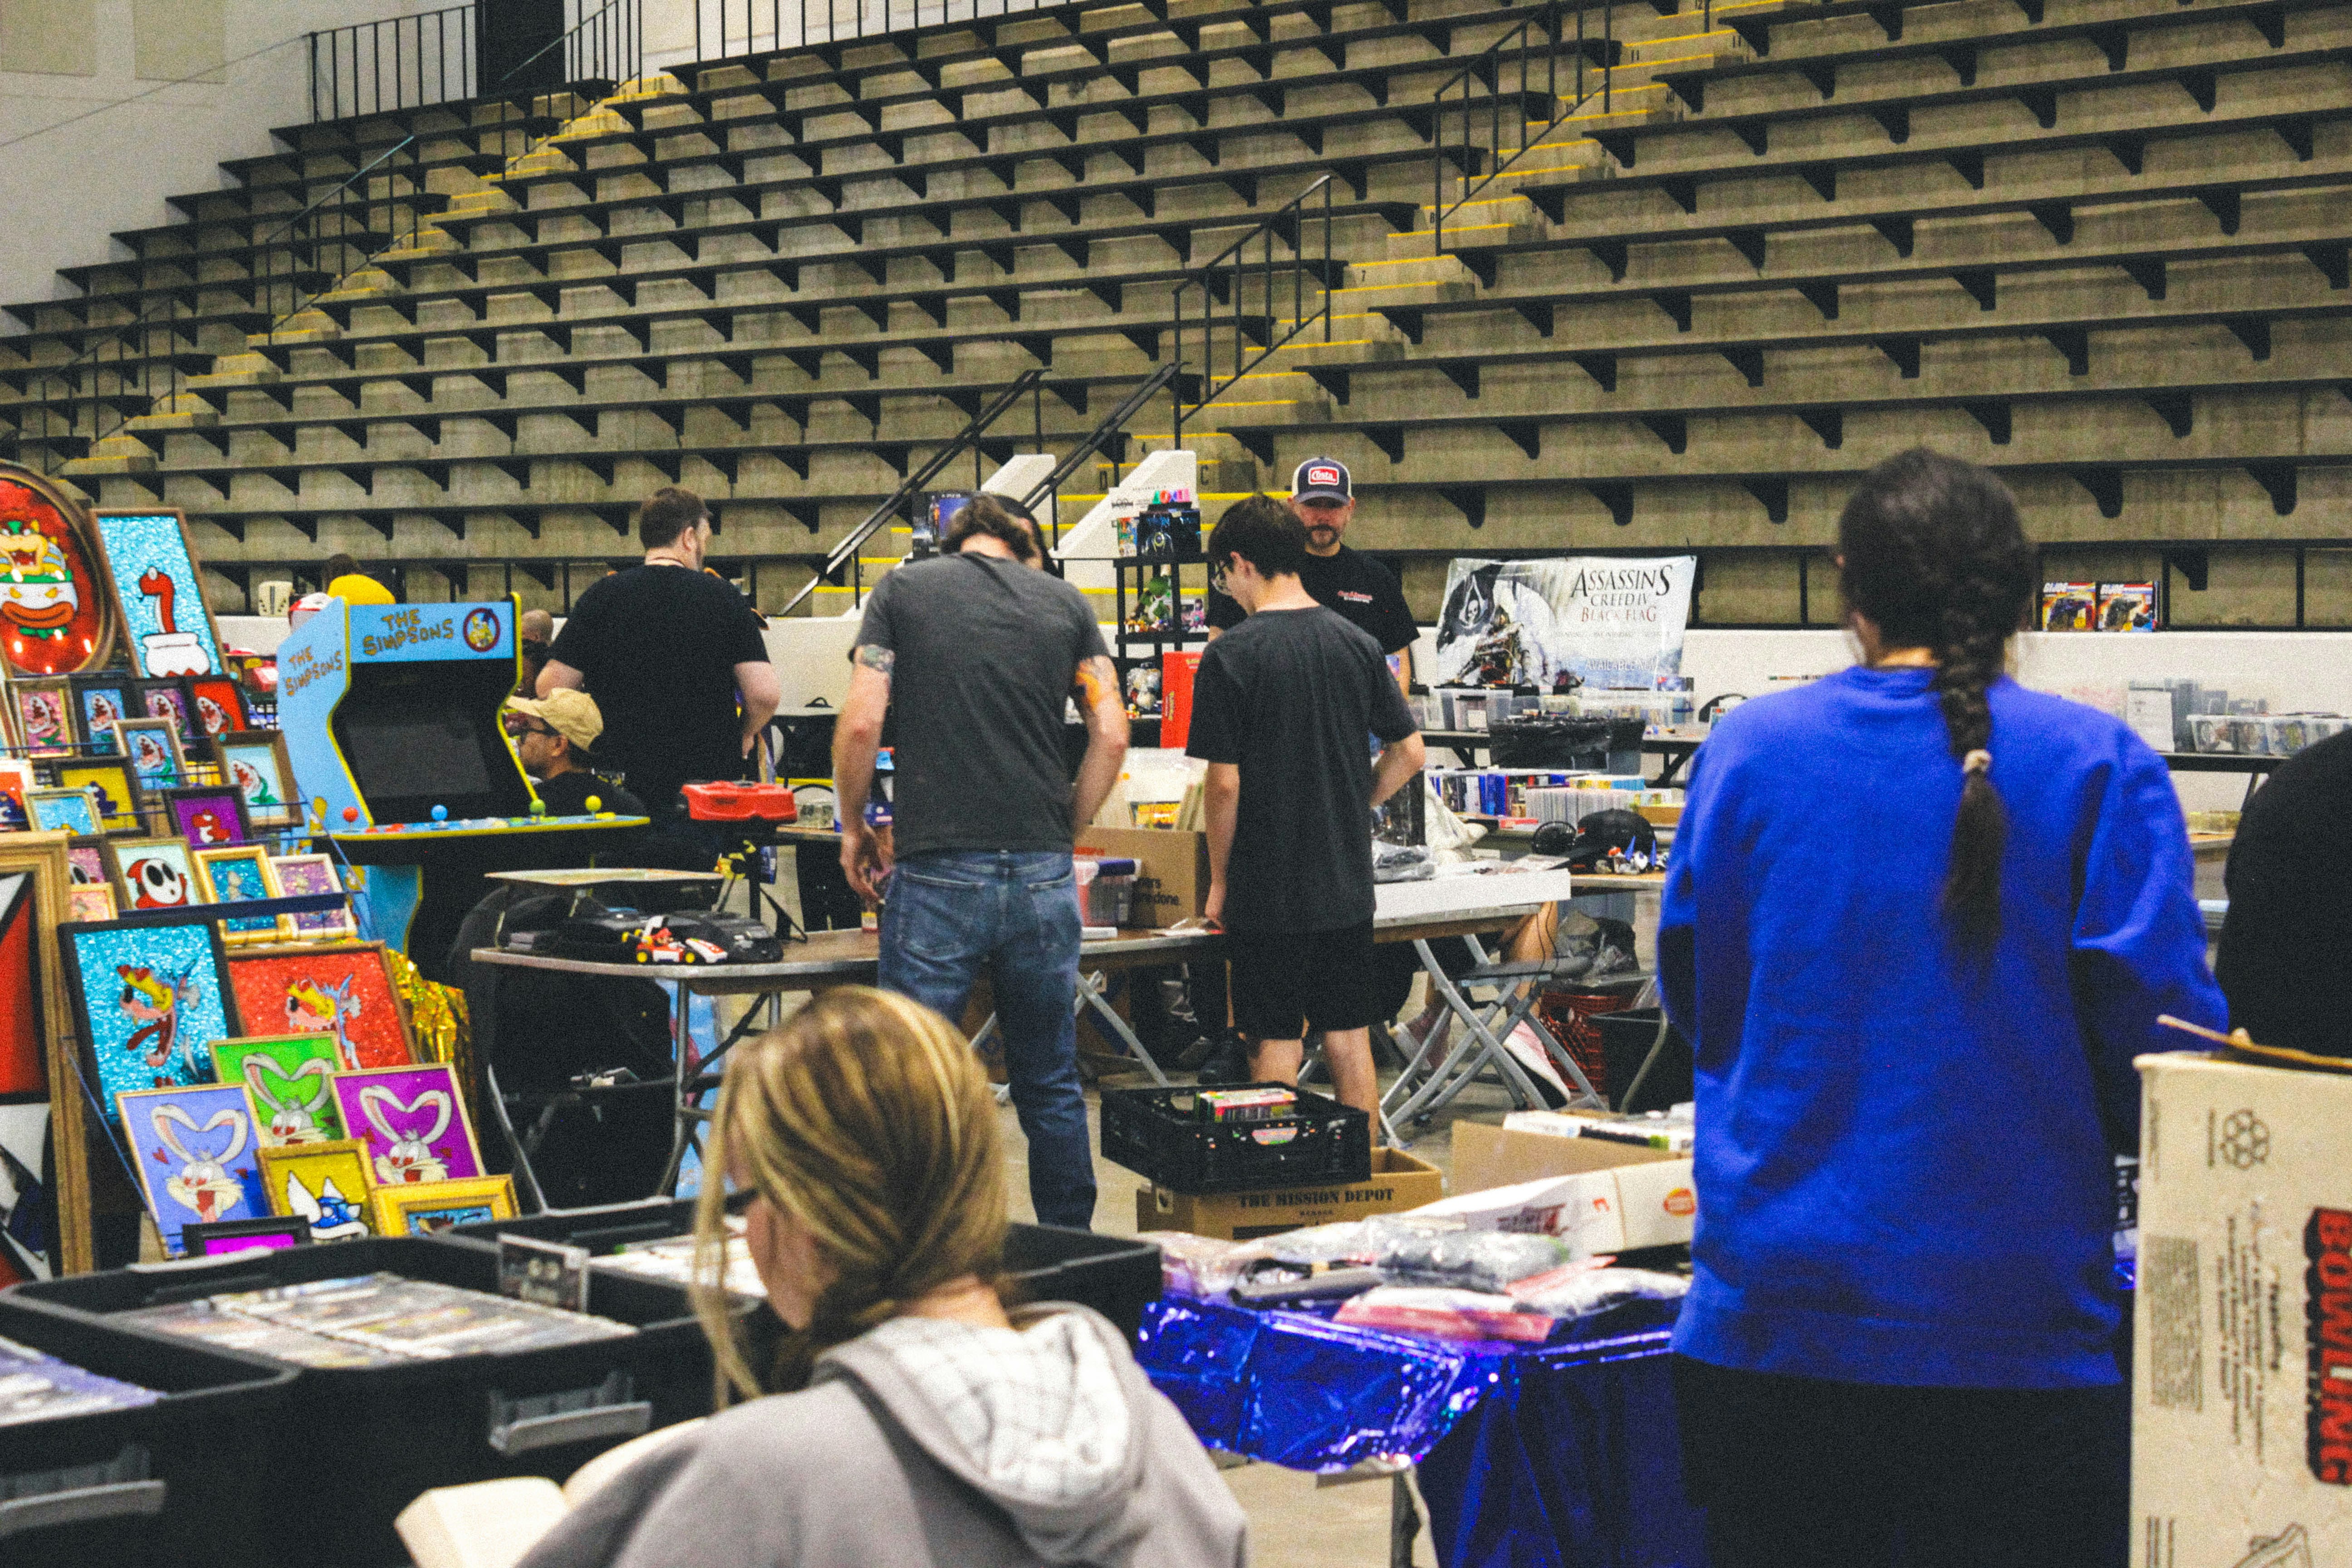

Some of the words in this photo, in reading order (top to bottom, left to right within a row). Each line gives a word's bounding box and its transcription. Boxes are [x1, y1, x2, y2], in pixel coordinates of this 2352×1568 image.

[1590, 593, 1635, 607] CREED
[382, 609, 421, 631] THE
[1581, 606, 1621, 622] BLACK
[1625, 605, 1657, 622] FLAG
[363, 619, 454, 656] SIMPSONS
[288, 646, 313, 670] THE
[285, 651, 343, 696] SIMPSONS
[1240, 1194, 1270, 1208] THE
[1275, 1191, 1339, 1206] MISSION
[1344, 1188, 1394, 1203] DEPOT
[2314, 1208, 2352, 1485] BOWLING
